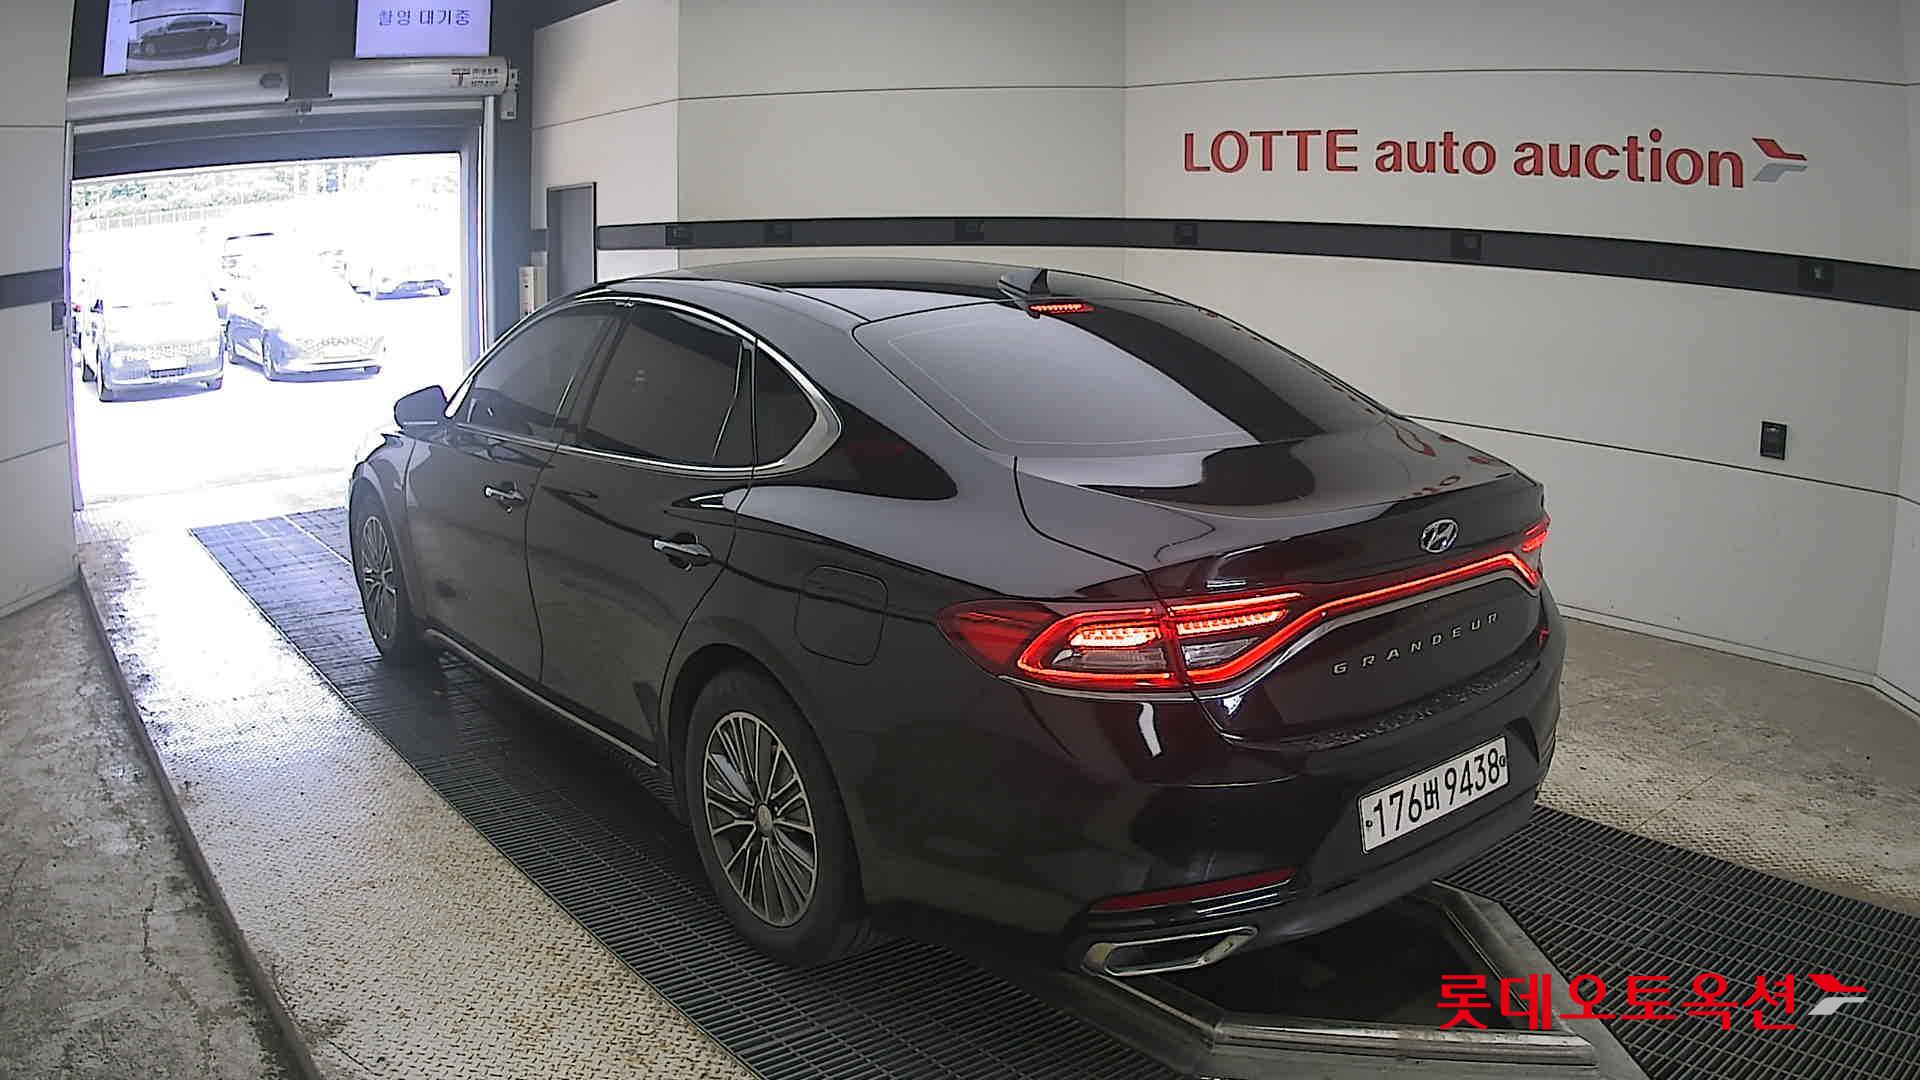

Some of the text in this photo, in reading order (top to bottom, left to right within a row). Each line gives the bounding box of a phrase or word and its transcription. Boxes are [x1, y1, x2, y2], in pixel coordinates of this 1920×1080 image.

[418, 9, 470, 26] 대기중
[1184, 128, 1744, 188] LOTTE auto auction
[1332, 612, 1498, 675] GRANDEUR
